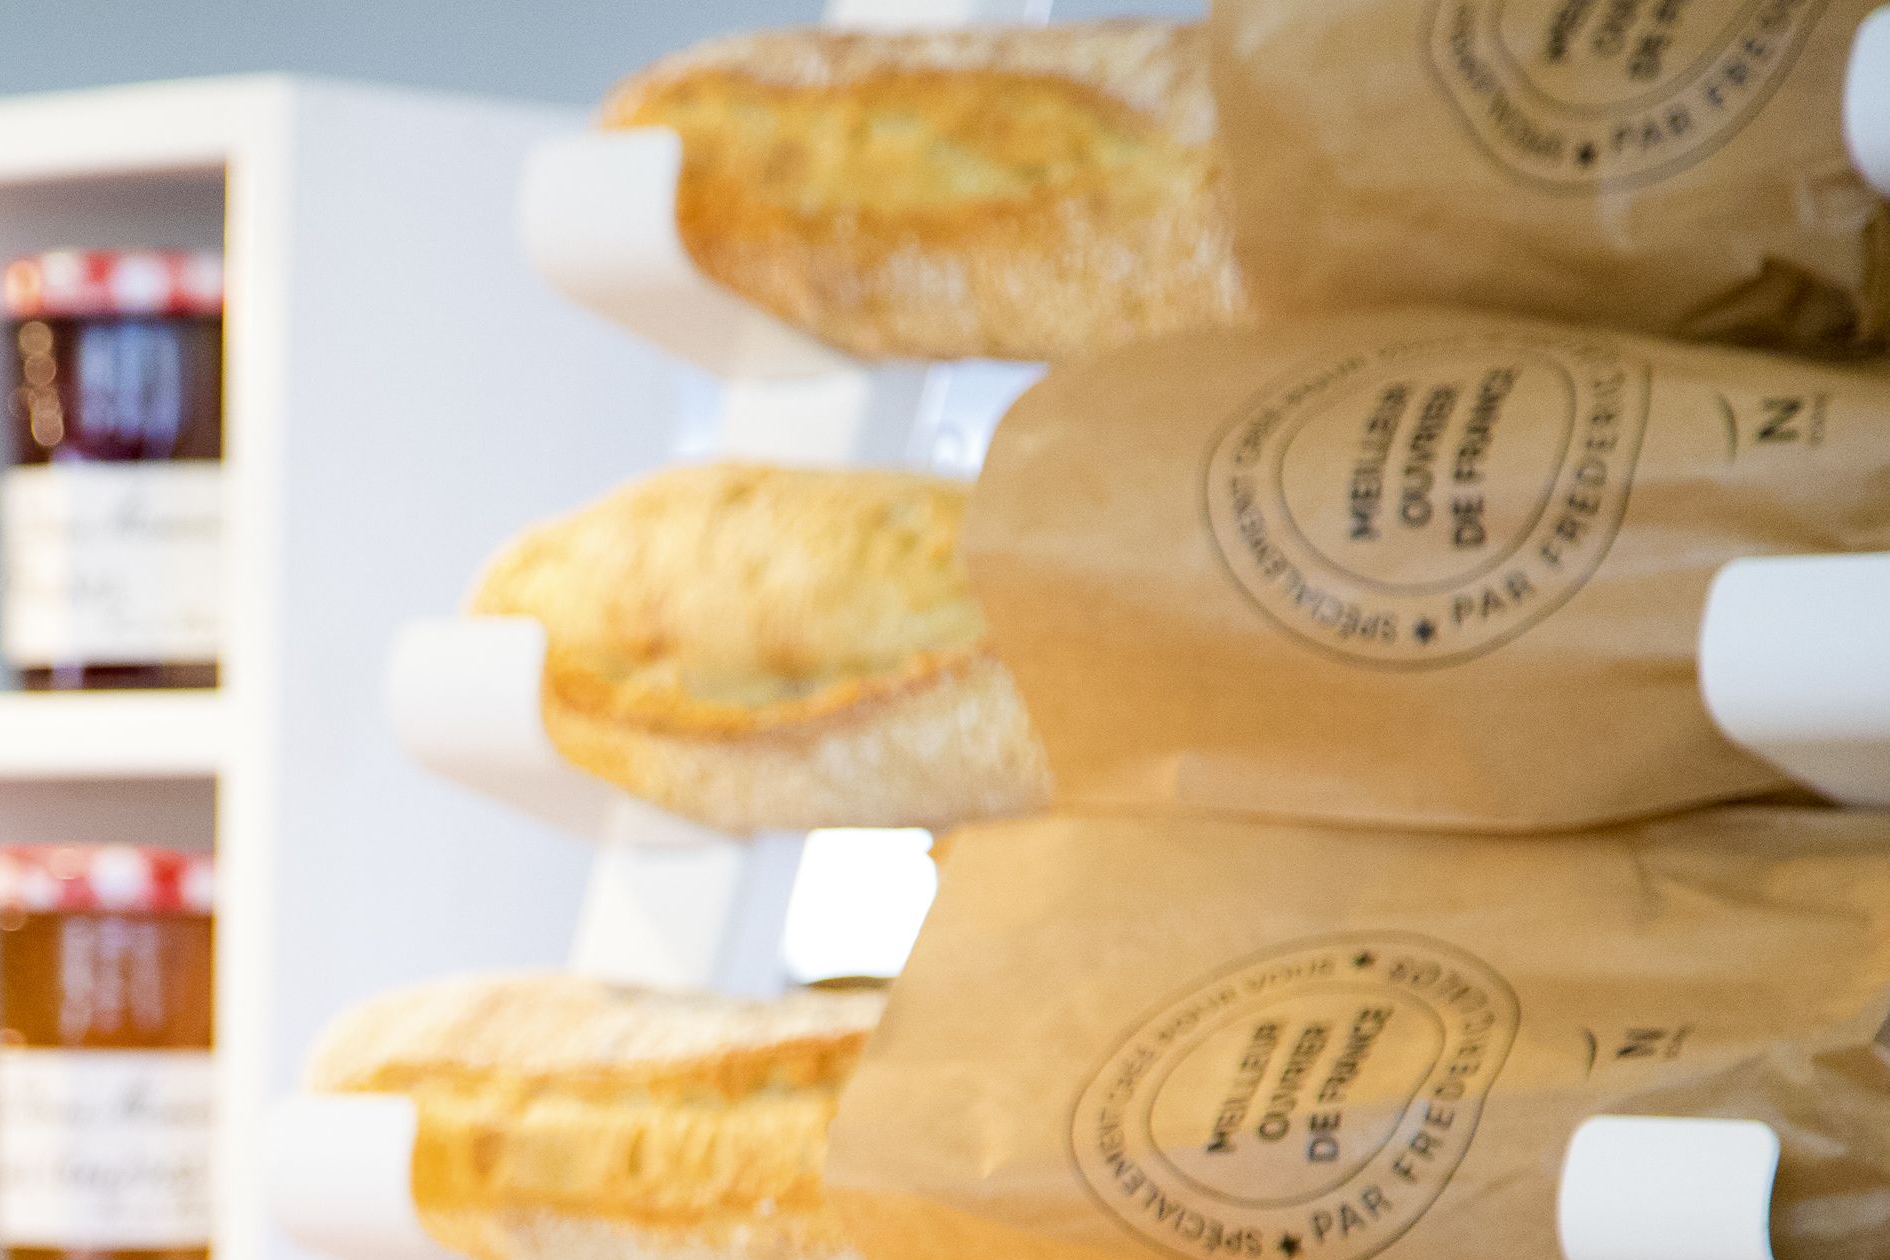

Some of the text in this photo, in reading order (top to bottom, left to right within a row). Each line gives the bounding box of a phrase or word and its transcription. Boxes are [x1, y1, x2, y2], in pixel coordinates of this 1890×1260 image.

[1451, 496, 1486, 549] DE
[1452, 568, 1535, 625] PAR
[1308, 1111, 1342, 1161] DE
[1311, 1184, 1393, 1243] PAR
